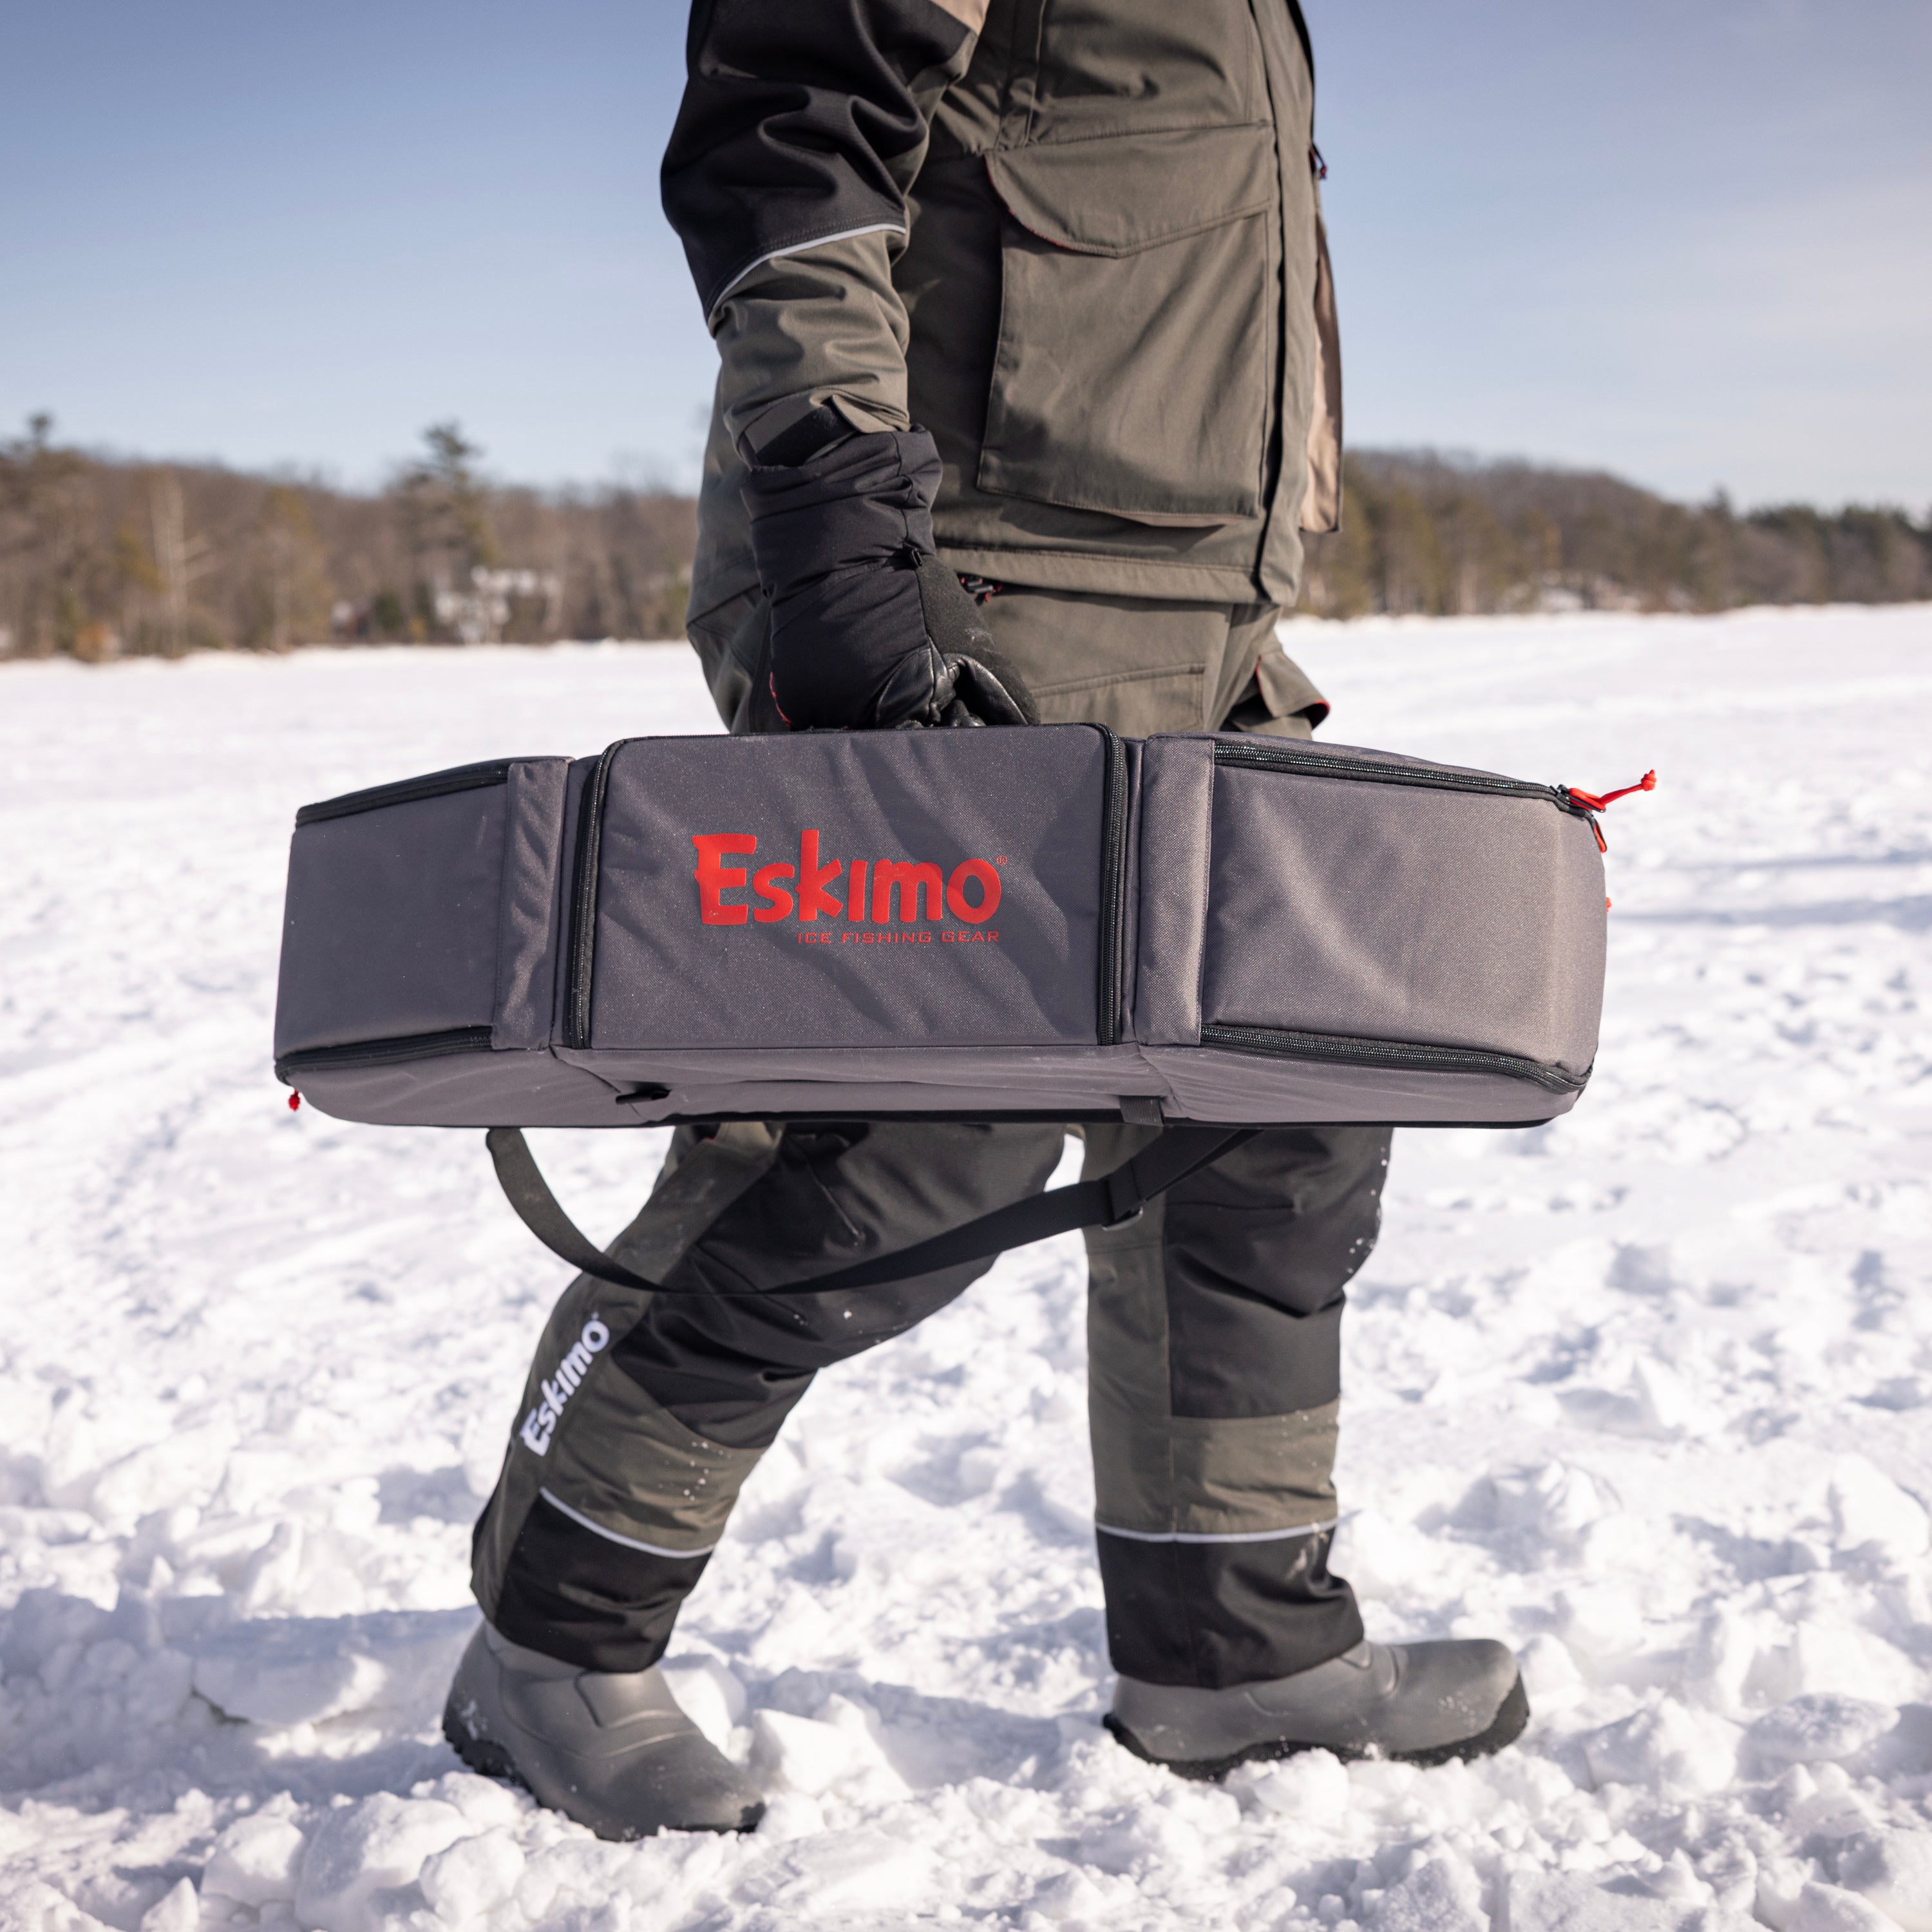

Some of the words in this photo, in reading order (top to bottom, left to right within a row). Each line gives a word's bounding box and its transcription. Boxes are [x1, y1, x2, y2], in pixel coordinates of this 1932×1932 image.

[692, 829, 1001, 926] Eskimo
[797, 933, 832, 944] ICE
[842, 931, 932, 944] FISHING
[941, 931, 999, 943] GEAR
[519, 1320, 610, 1457] Eskimo
